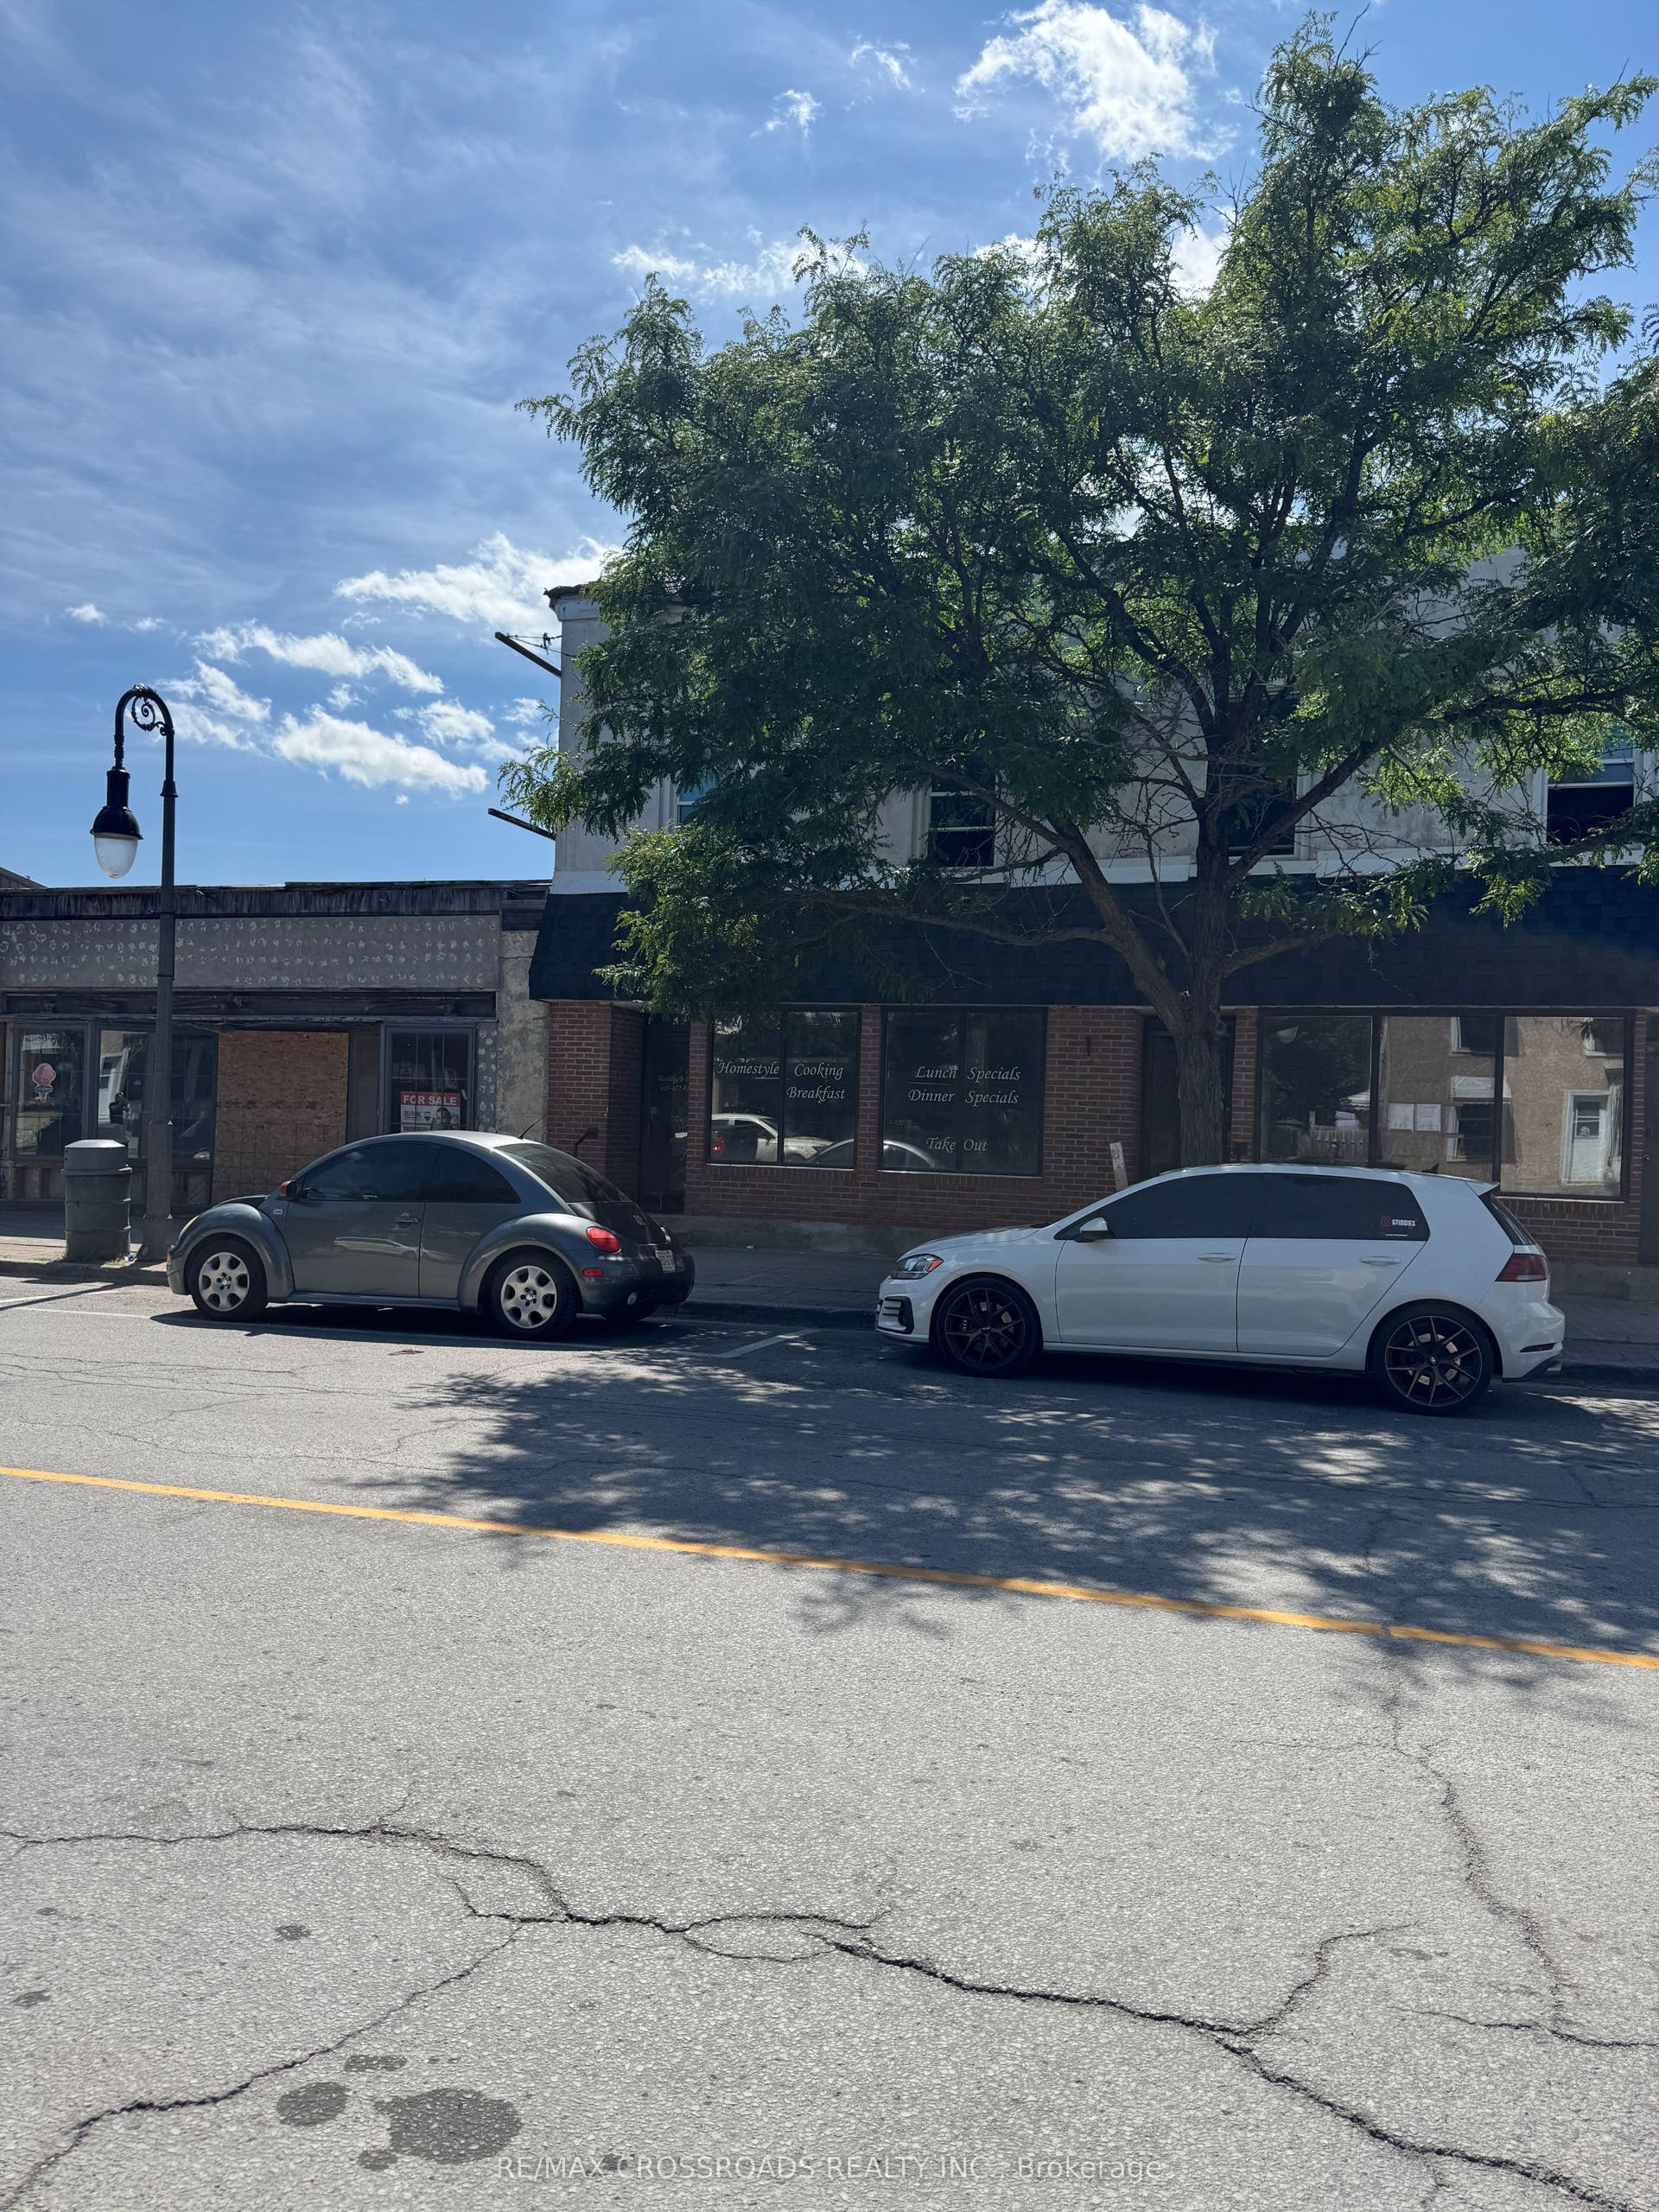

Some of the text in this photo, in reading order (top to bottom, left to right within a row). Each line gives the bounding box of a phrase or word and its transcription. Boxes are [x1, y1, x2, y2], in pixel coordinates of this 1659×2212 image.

[718, 1062, 843, 1080] Homestyle Cooking
[915, 1065, 1020, 1083] Lunch Specials
[404, 1095, 456, 1106] FOR SALE
[786, 1085, 846, 1103] Breakfast
[908, 1089, 1019, 1106] Dinner Specials
[925, 1137, 988, 1154] Take Out
